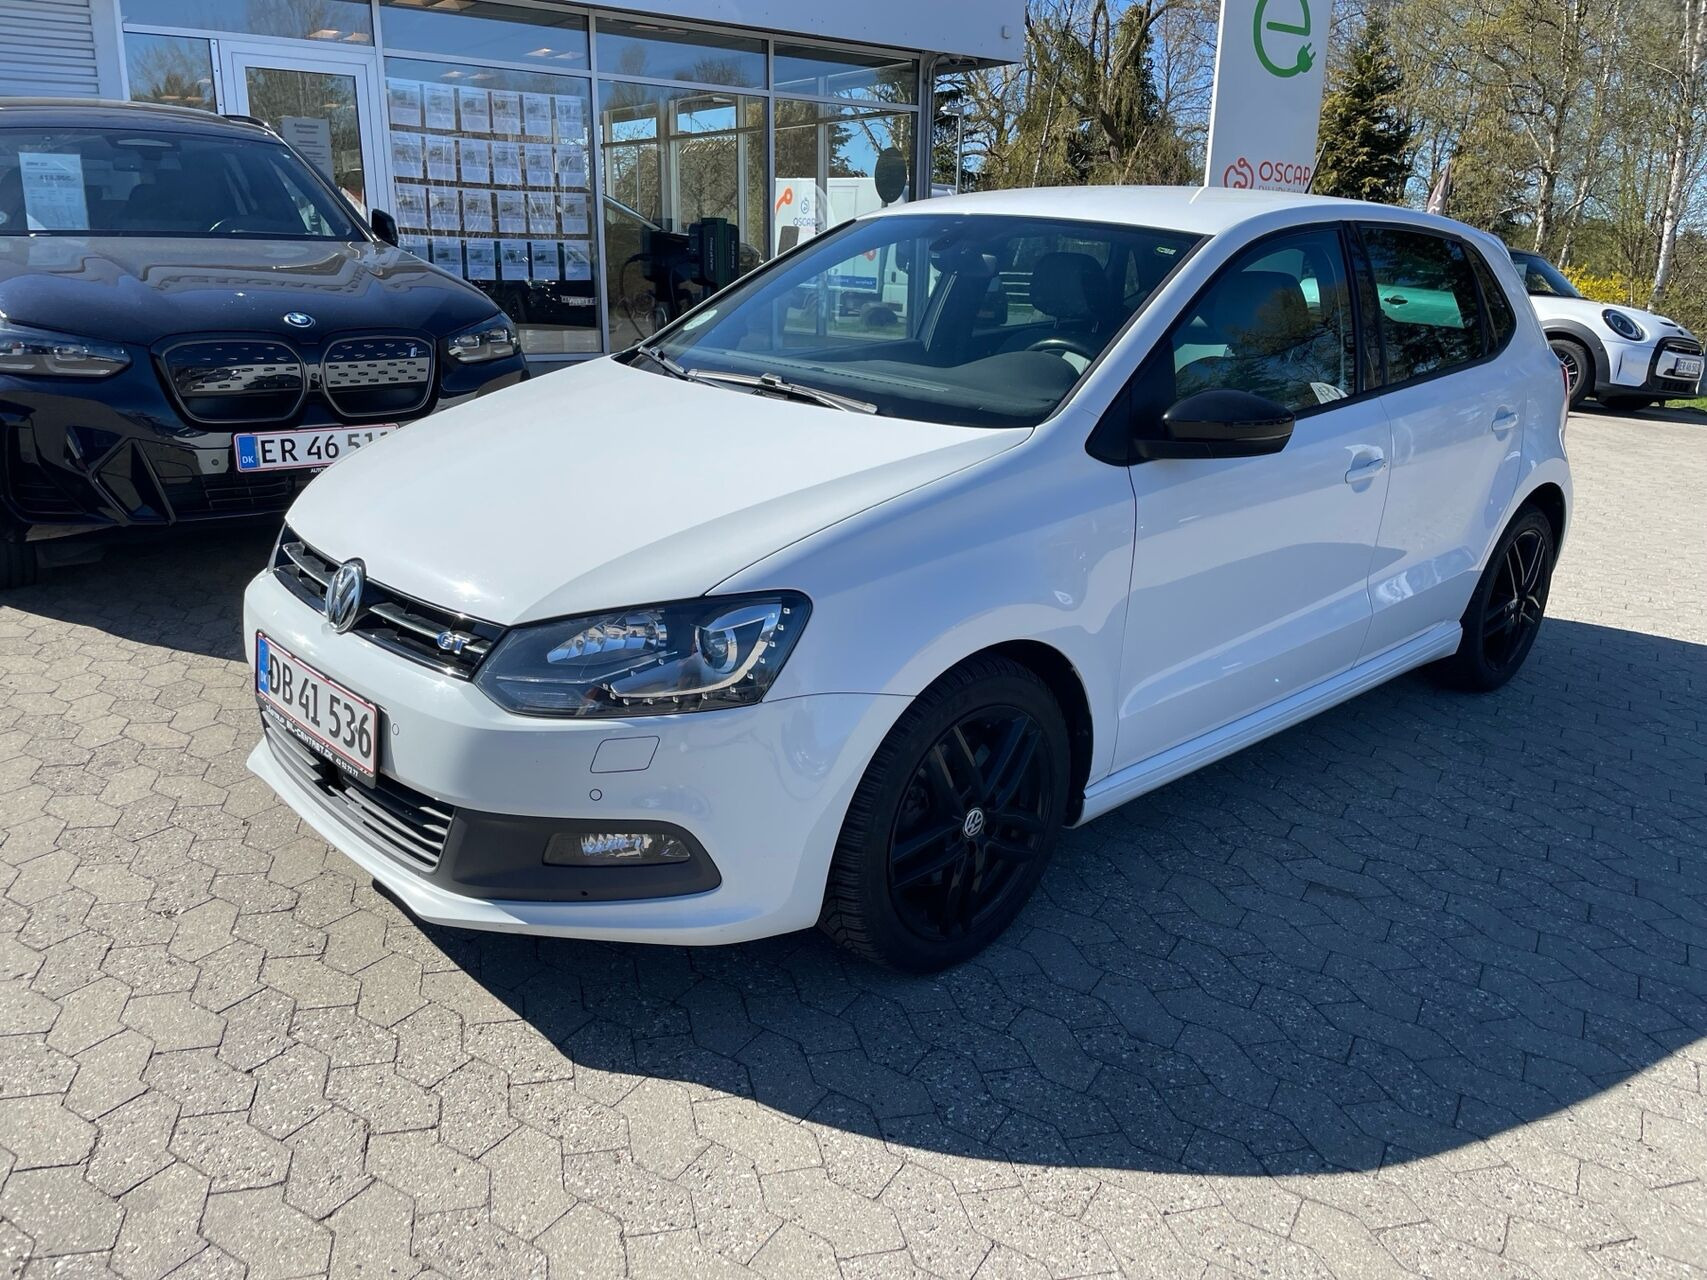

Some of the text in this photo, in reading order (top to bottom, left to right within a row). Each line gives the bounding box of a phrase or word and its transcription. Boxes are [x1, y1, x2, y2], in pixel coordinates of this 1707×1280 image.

[1259, 161, 1311, 186] OSCAR
[242, 455, 254, 464] DK
[260, 438, 298, 464] ER
[307, 434, 340, 460] 46
[437, 631, 470, 655] GT
[269, 653, 372, 759] DB 41 536
